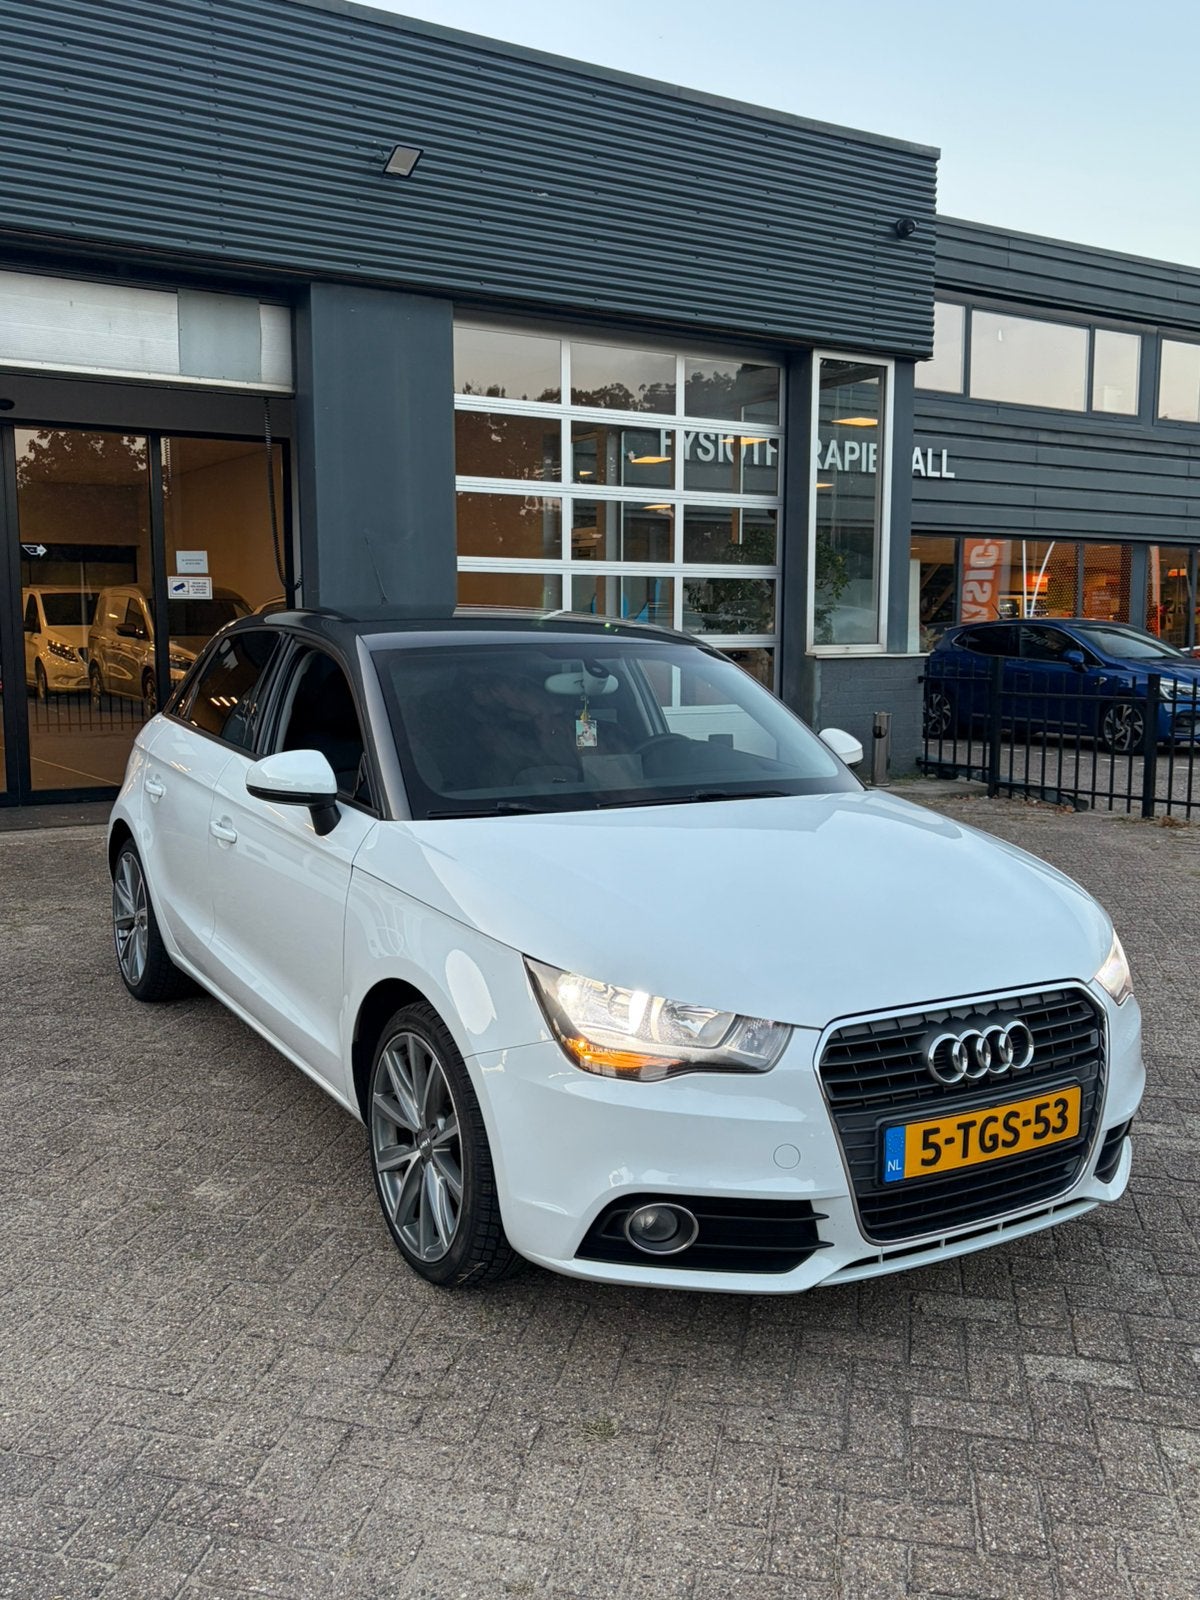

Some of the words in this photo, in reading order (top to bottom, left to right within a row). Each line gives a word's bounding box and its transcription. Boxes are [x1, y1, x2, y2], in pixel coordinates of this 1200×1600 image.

[661, 430, 877, 473] FYSIOTRAPIE
[887, 1160, 902, 1172] NL
[920, 1098, 1069, 1167] 5-TGS-53
